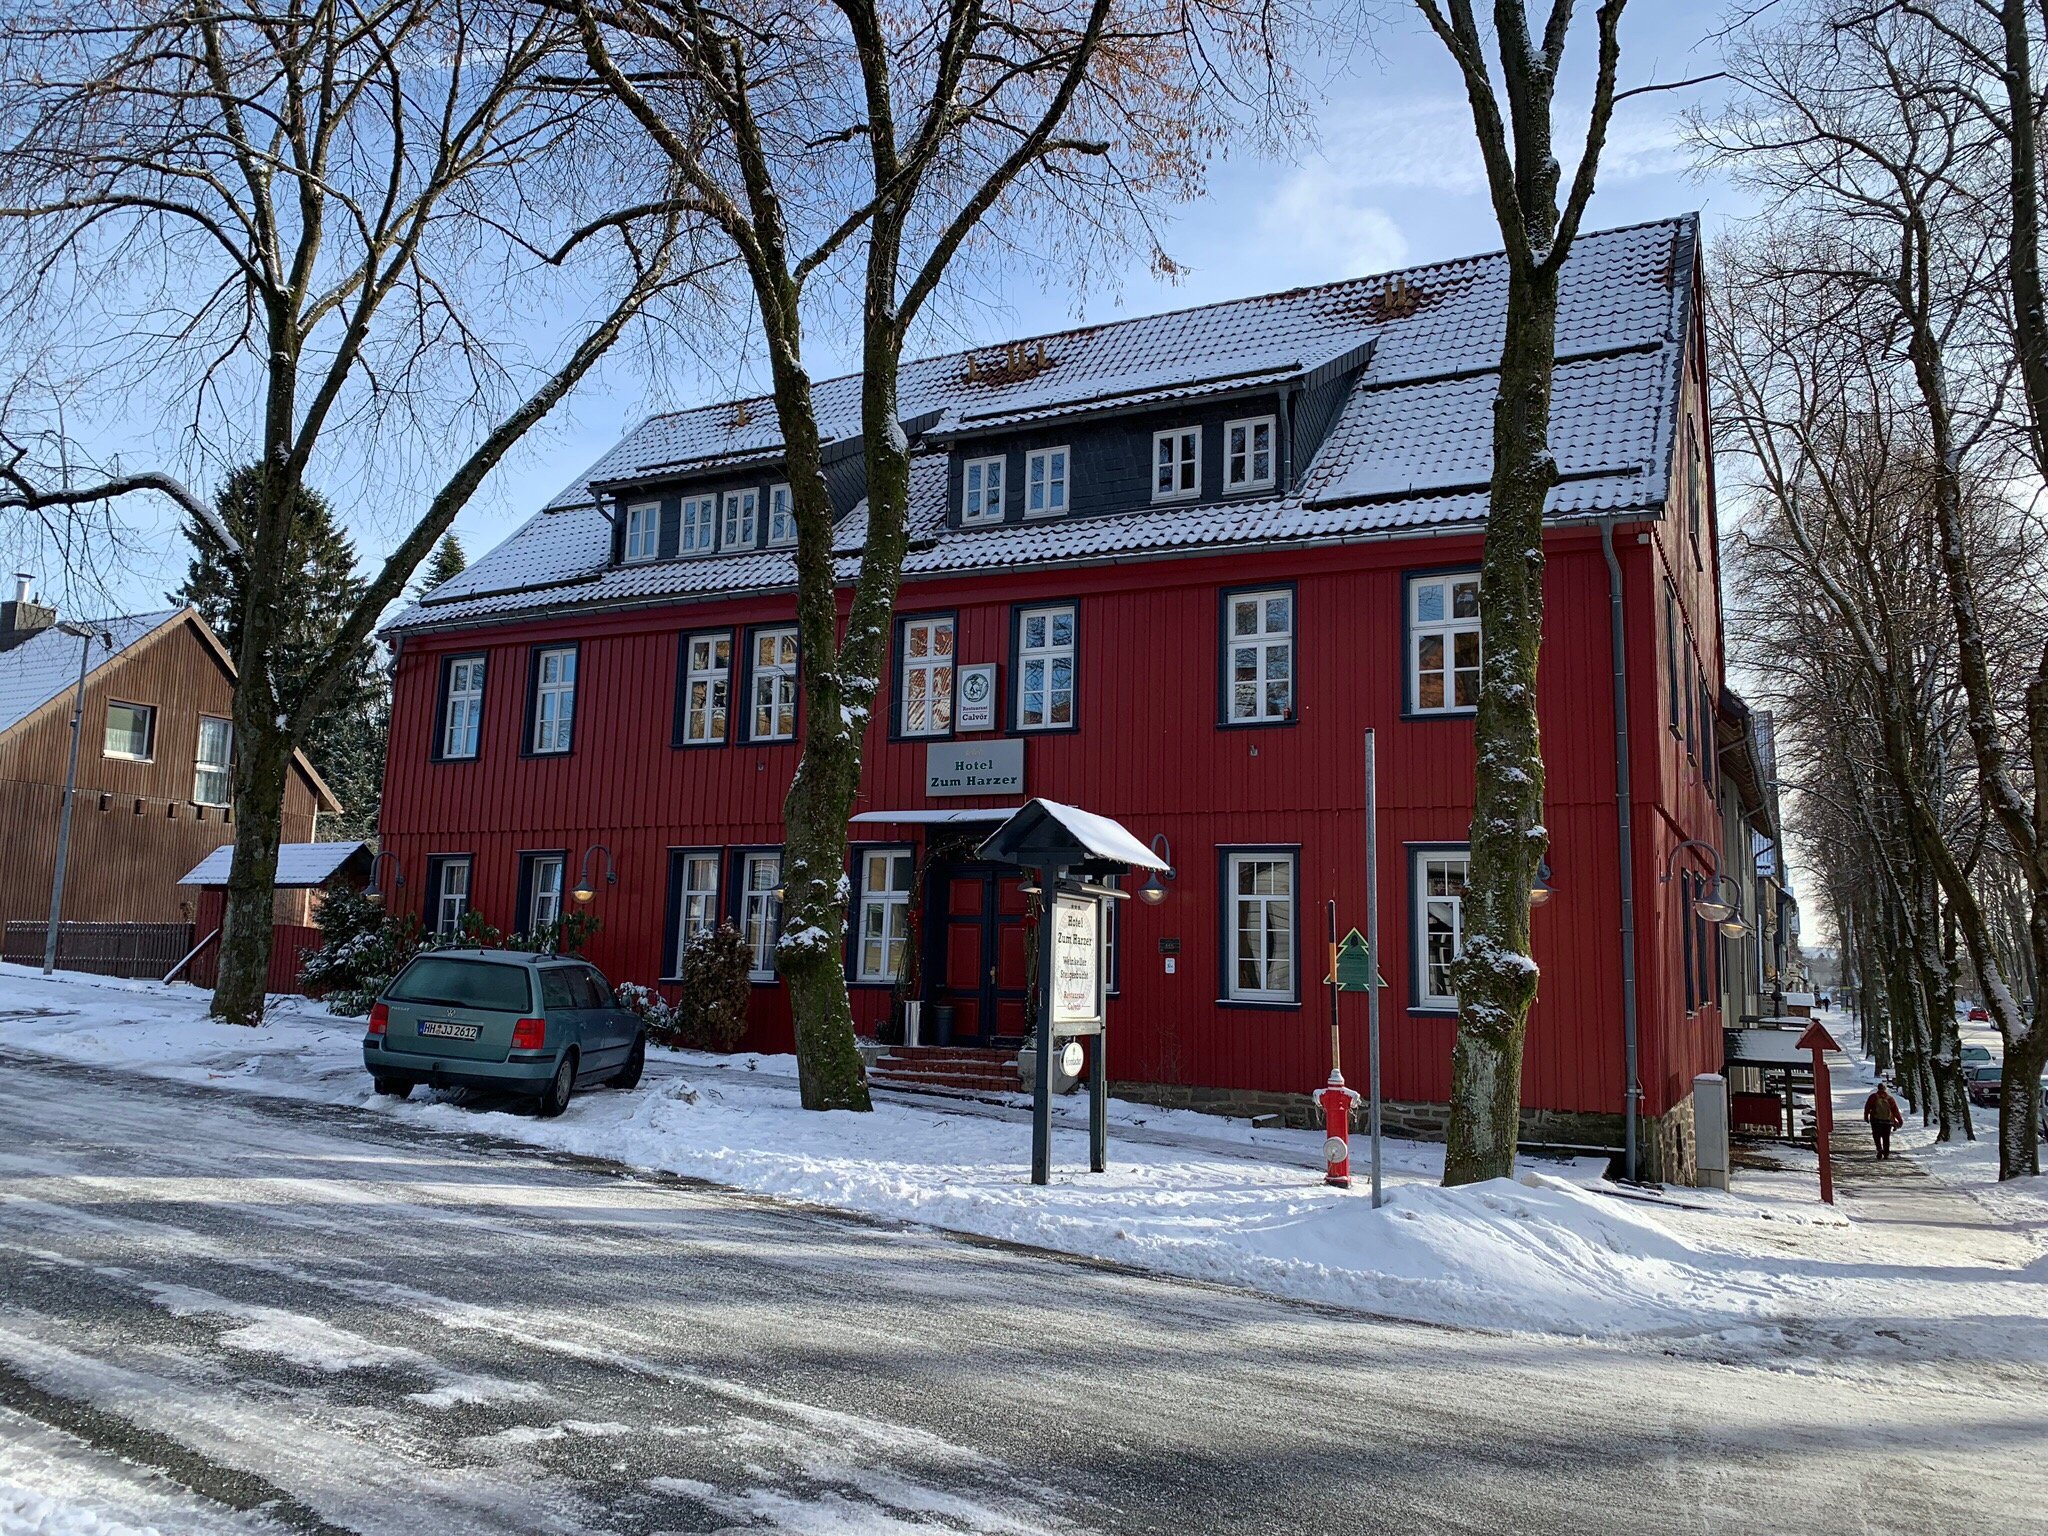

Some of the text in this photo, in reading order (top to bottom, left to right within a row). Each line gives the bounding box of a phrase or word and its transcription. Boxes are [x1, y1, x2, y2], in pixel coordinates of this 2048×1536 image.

[962, 713, 988, 721] Calvör
[954, 760, 993, 771] Hotel
[930, 775, 1018, 787] Zum Harzer
[1067, 915, 1084, 928] Hotel
[1057, 931, 1092, 946] Zum Harzer
[423, 1023, 477, 1038] HH JJ 2612
